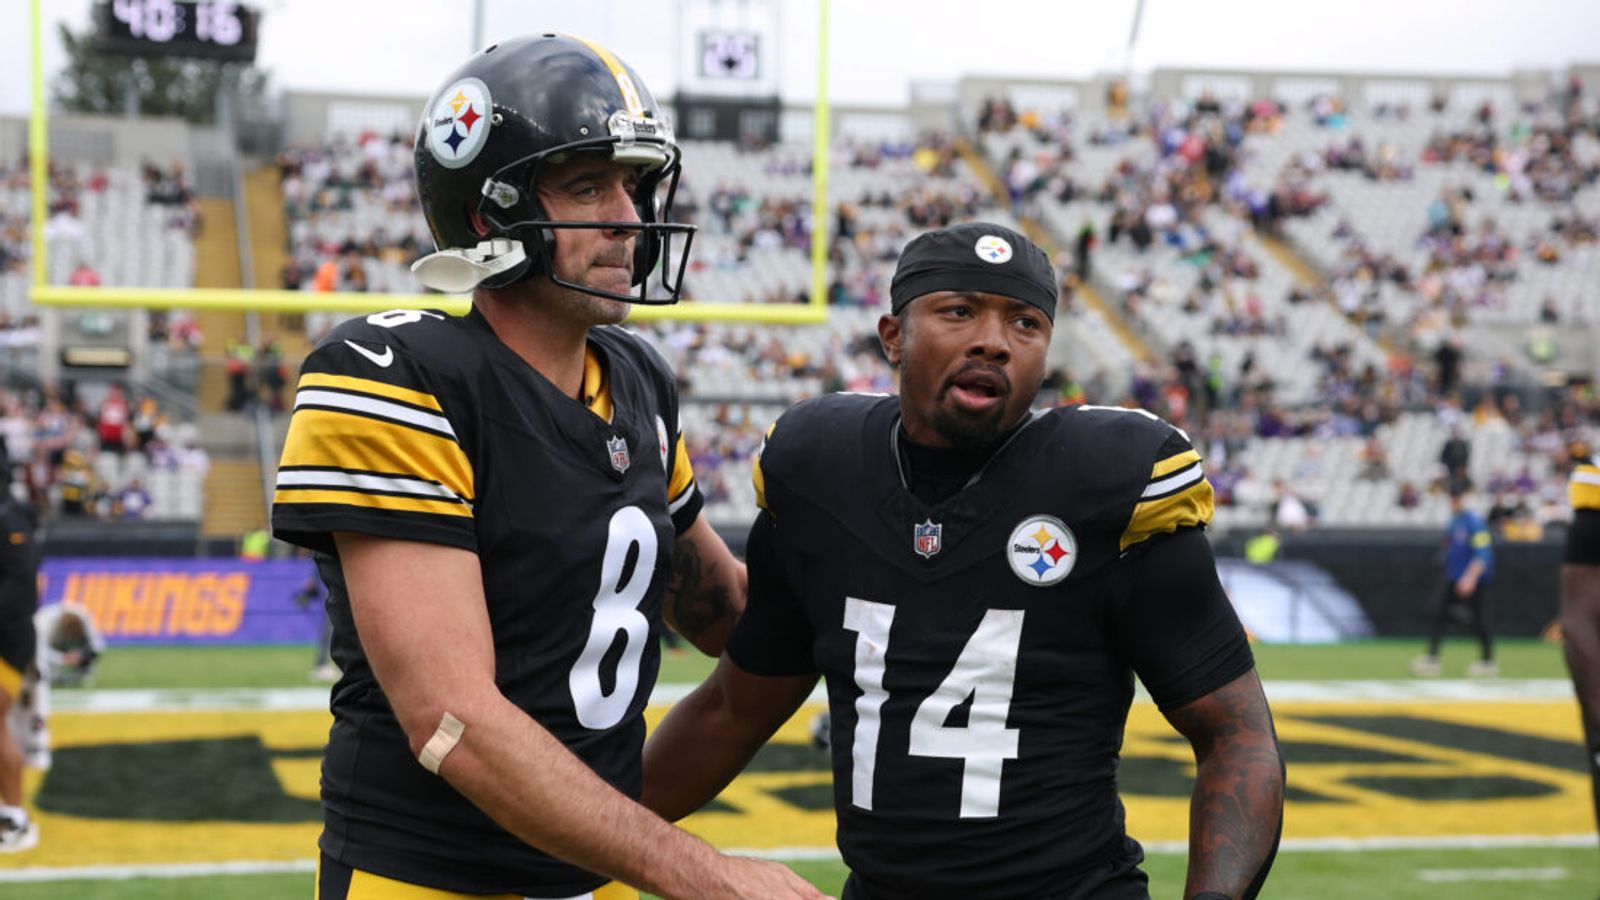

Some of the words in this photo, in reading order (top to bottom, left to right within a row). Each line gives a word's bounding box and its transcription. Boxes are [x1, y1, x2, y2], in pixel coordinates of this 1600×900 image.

[617, 72, 643, 119] 8
[918, 535, 938, 552] NFL
[1013, 543, 1041, 555] Steelers
[569, 505, 658, 730] 8
[842, 596, 1025, 818] 14
